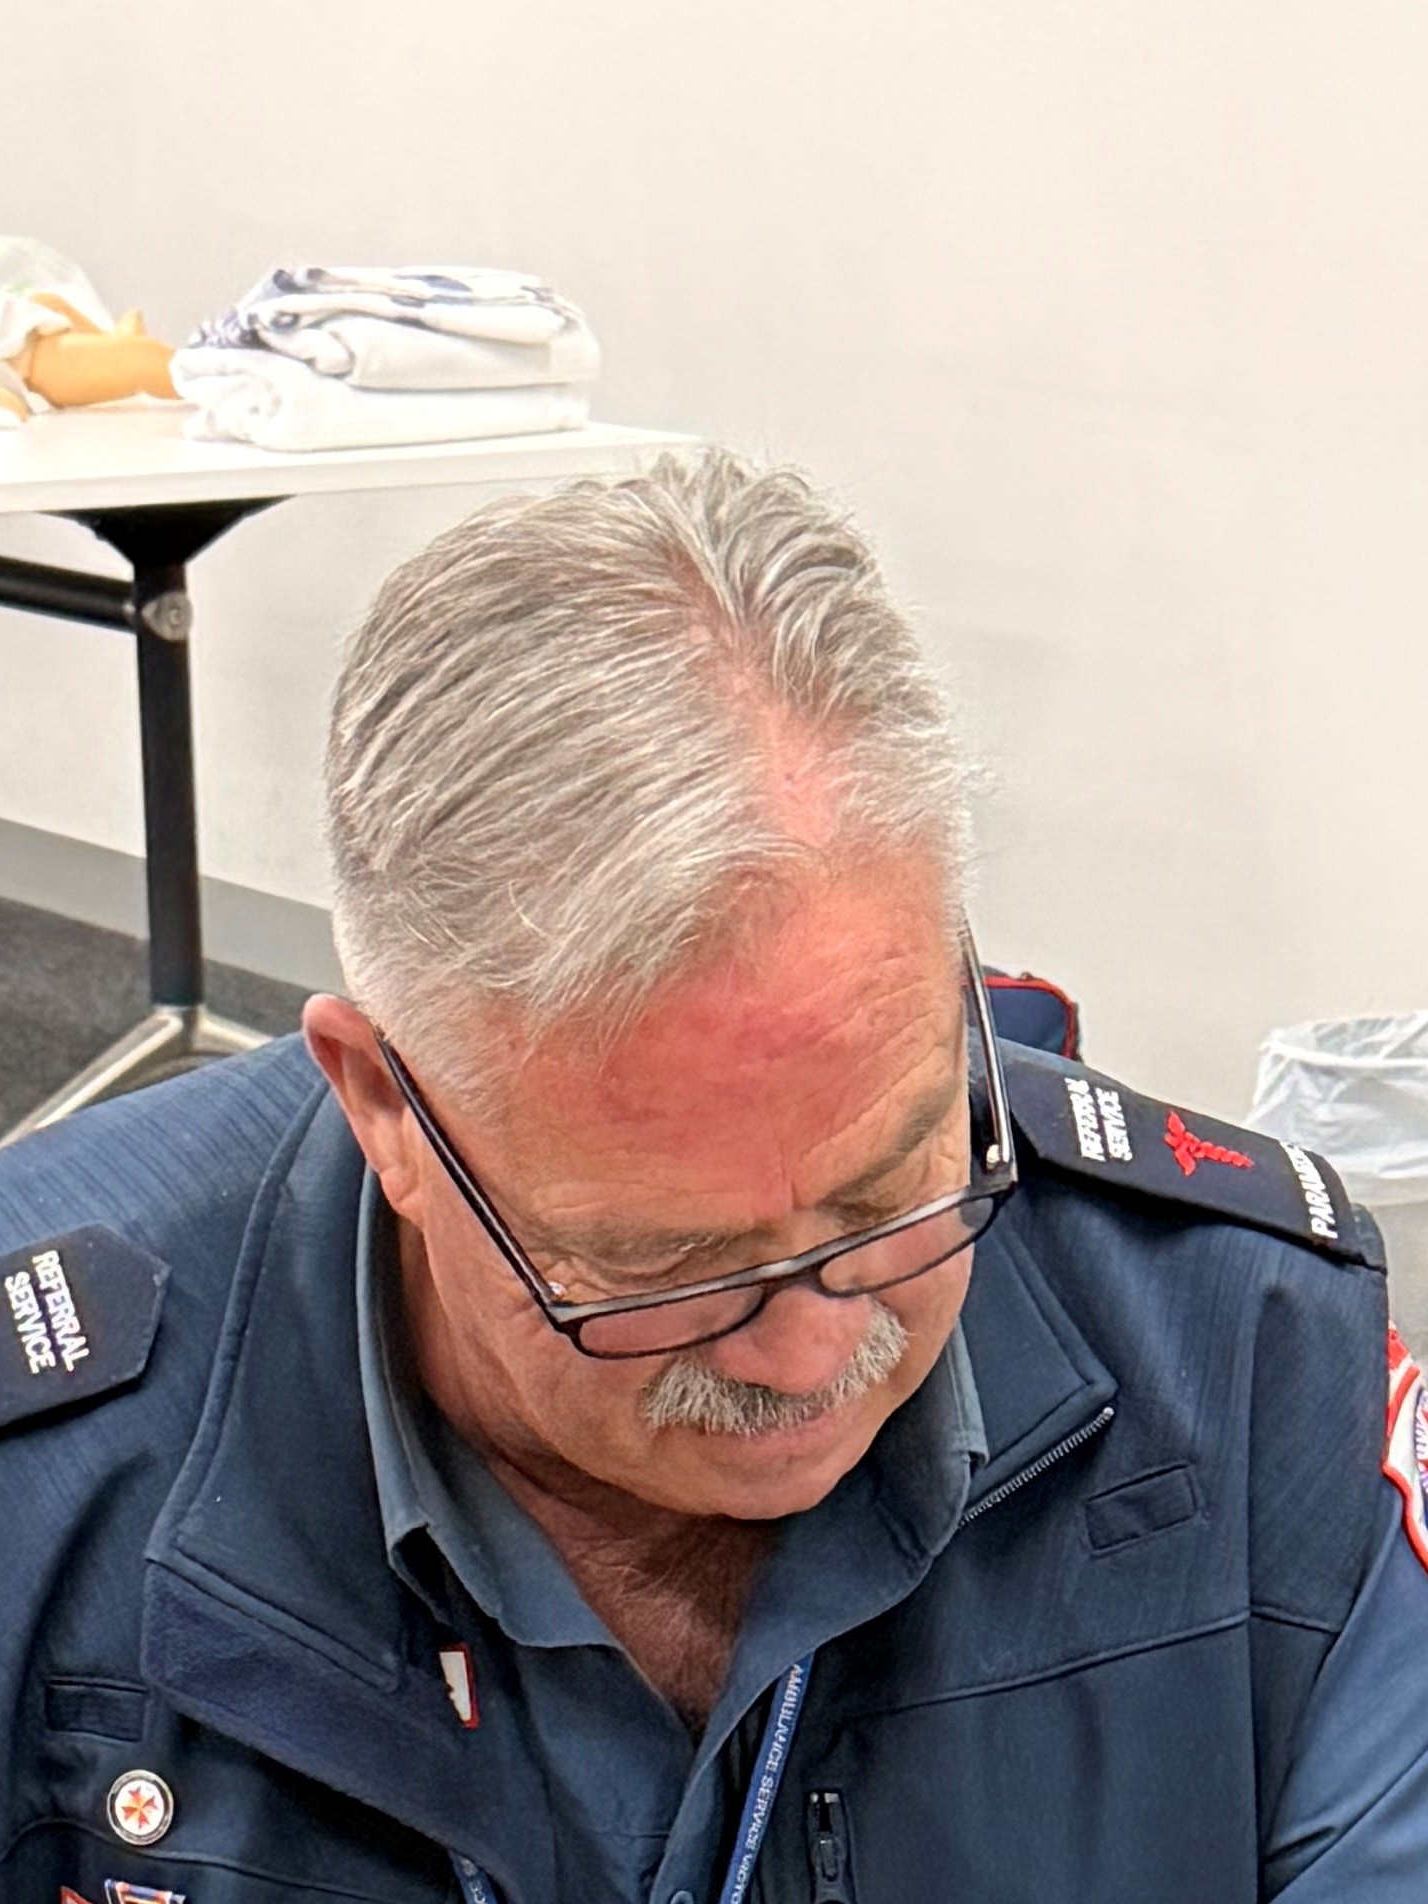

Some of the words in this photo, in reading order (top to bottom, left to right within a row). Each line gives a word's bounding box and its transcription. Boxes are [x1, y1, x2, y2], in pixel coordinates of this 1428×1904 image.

[2, 1272, 56, 1375] SERVICE
[32, 1250, 93, 1372] REFERRAL
[765, 1663, 804, 1774] AMBULANCE
[745, 1776, 775, 1850] SERVICE
